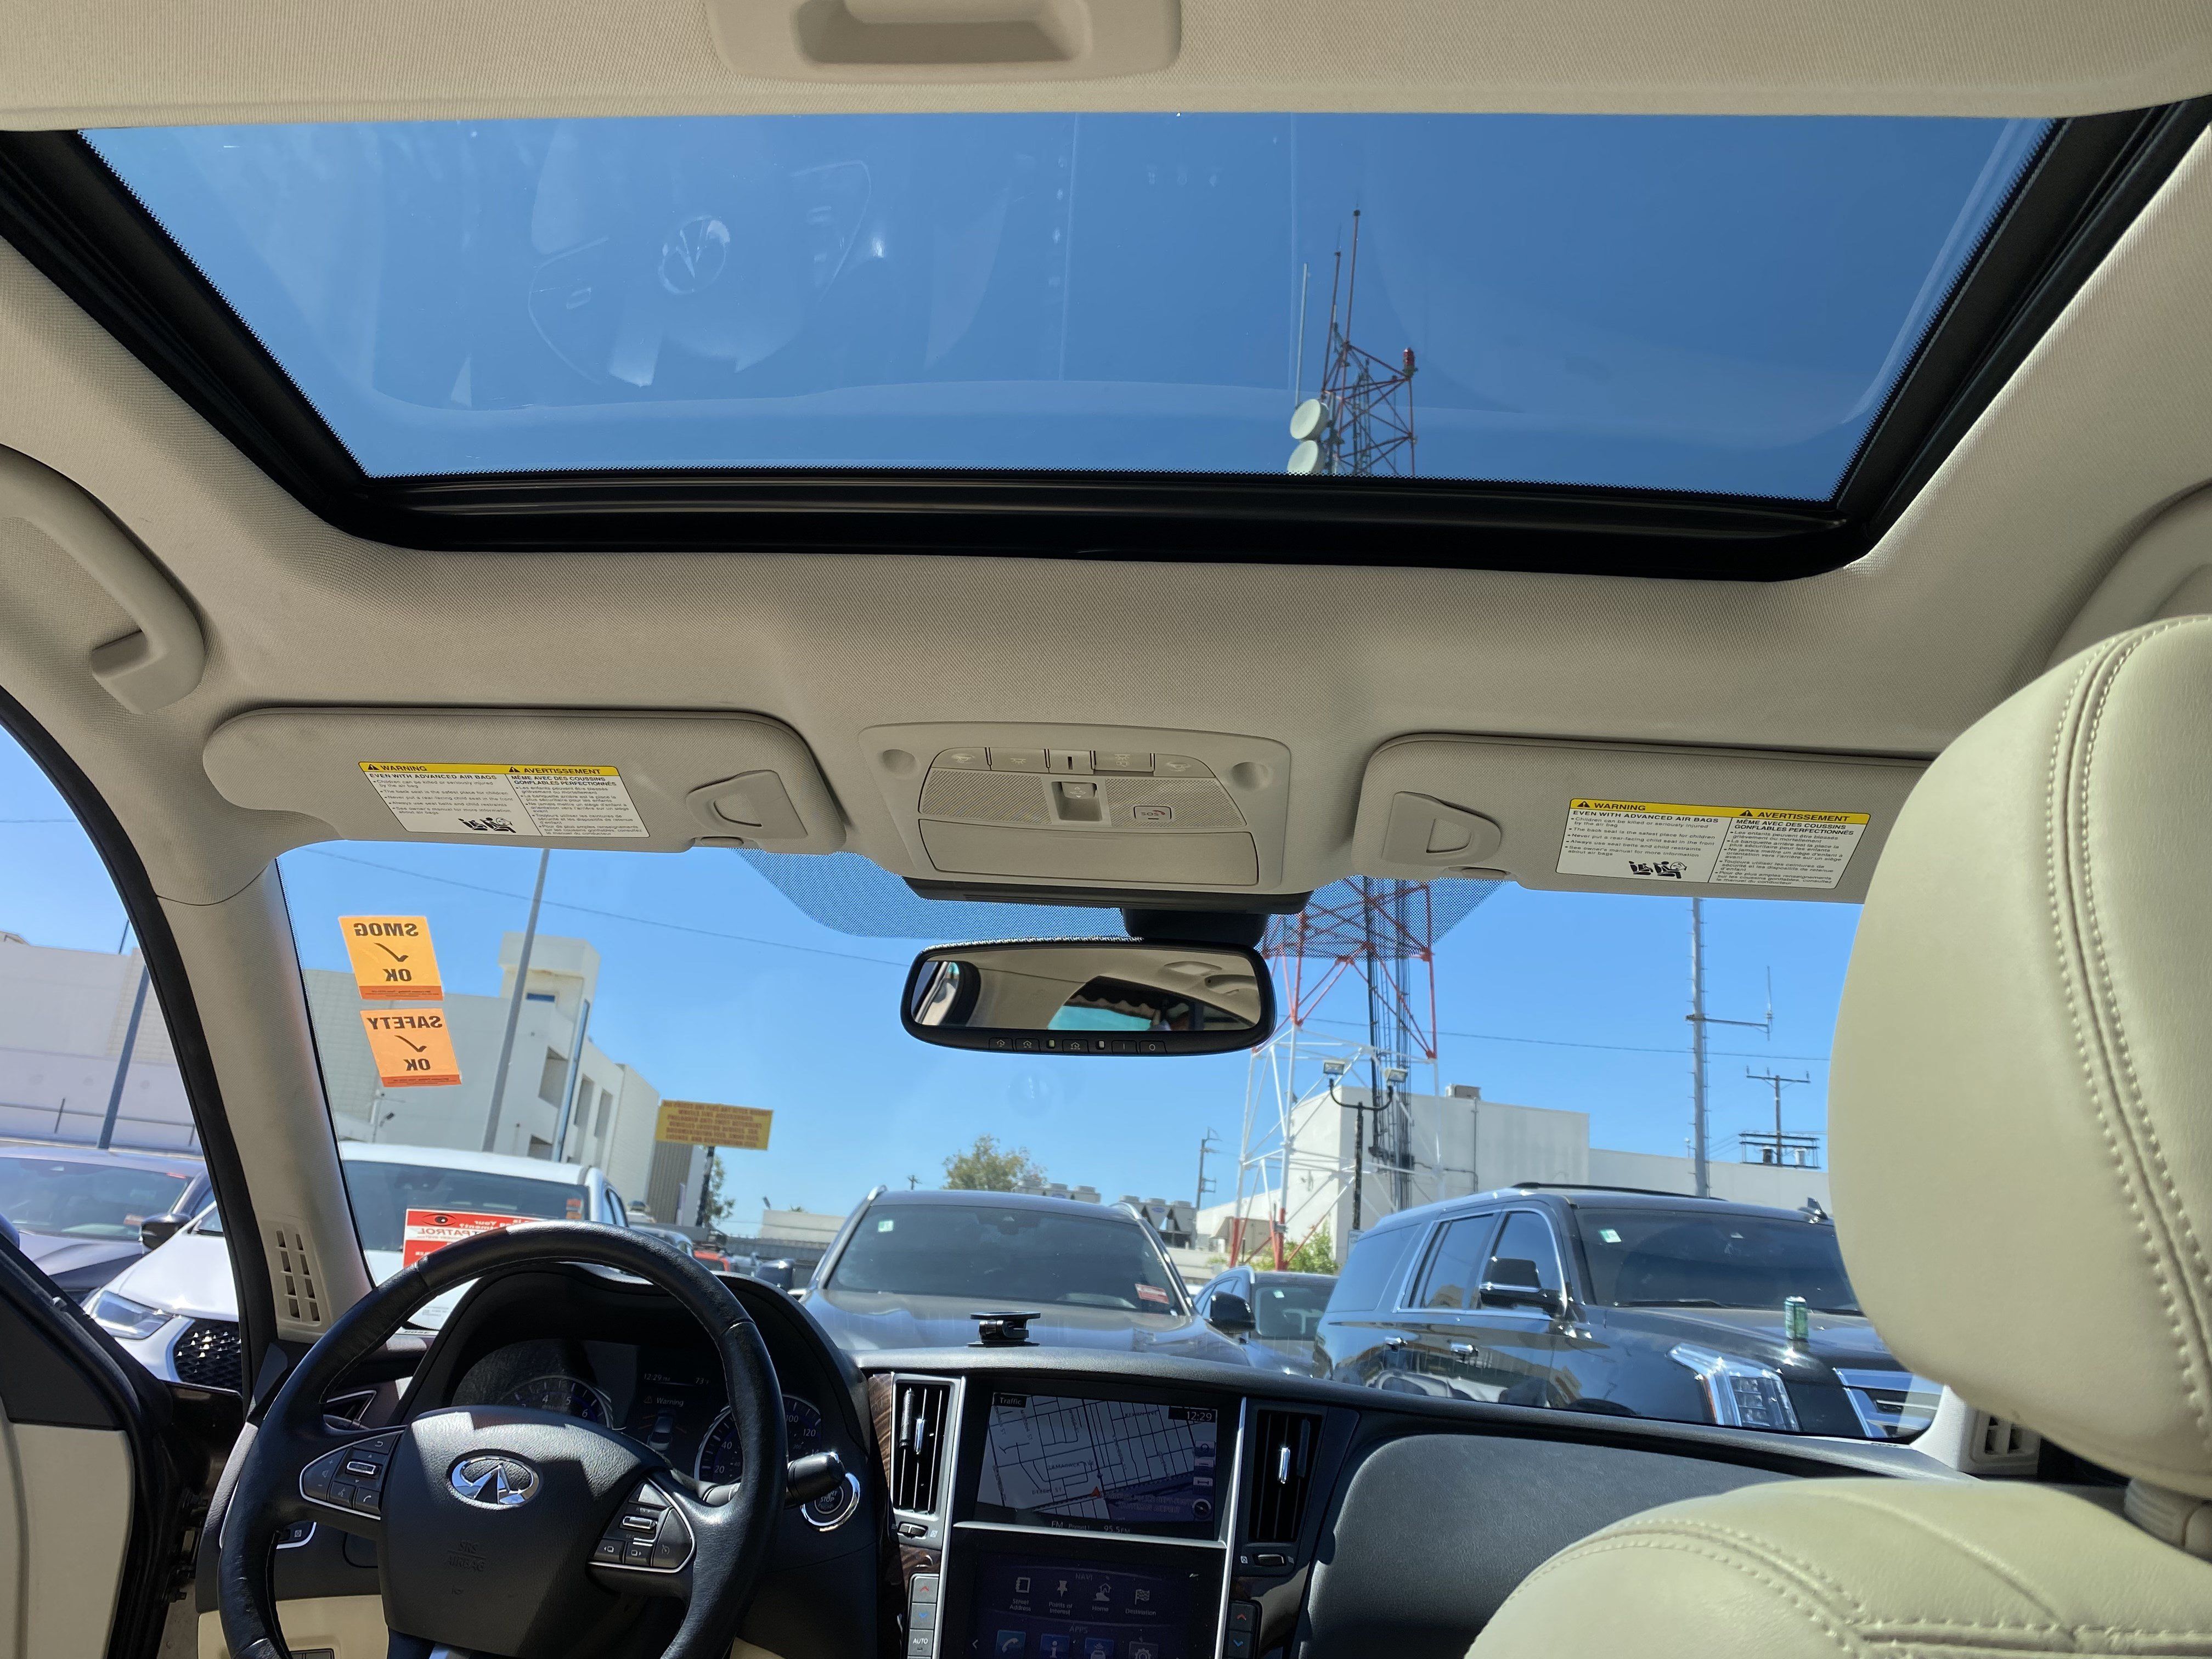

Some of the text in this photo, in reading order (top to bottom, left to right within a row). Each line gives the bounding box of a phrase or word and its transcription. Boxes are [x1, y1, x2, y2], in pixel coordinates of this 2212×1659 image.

[1594, 803, 1646, 811] WARNING
[1757, 812, 1850, 822] AVERTISSEMENT
[542, 1394, 549, 1403] 4
[566, 1396, 572, 1405] 5
[657, 1397, 684, 1407] Warning
[1000, 1397, 1022, 1406] Traffic
[582, 1409, 588, 1417] 6
[1187, 1411, 1212, 1421] 12:29
[786, 1414, 799, 1423] 100
[803, 1429, 816, 1437] 120
[721, 1441, 732, 1449] 40
[714, 1465, 725, 1474] 20
[1051, 1520, 1063, 1528] FM
[1075, 1573, 1093, 1581] NAVI
[1125, 1608, 1156, 1616] Destination
[1069, 1626, 1088, 1634] APPS
